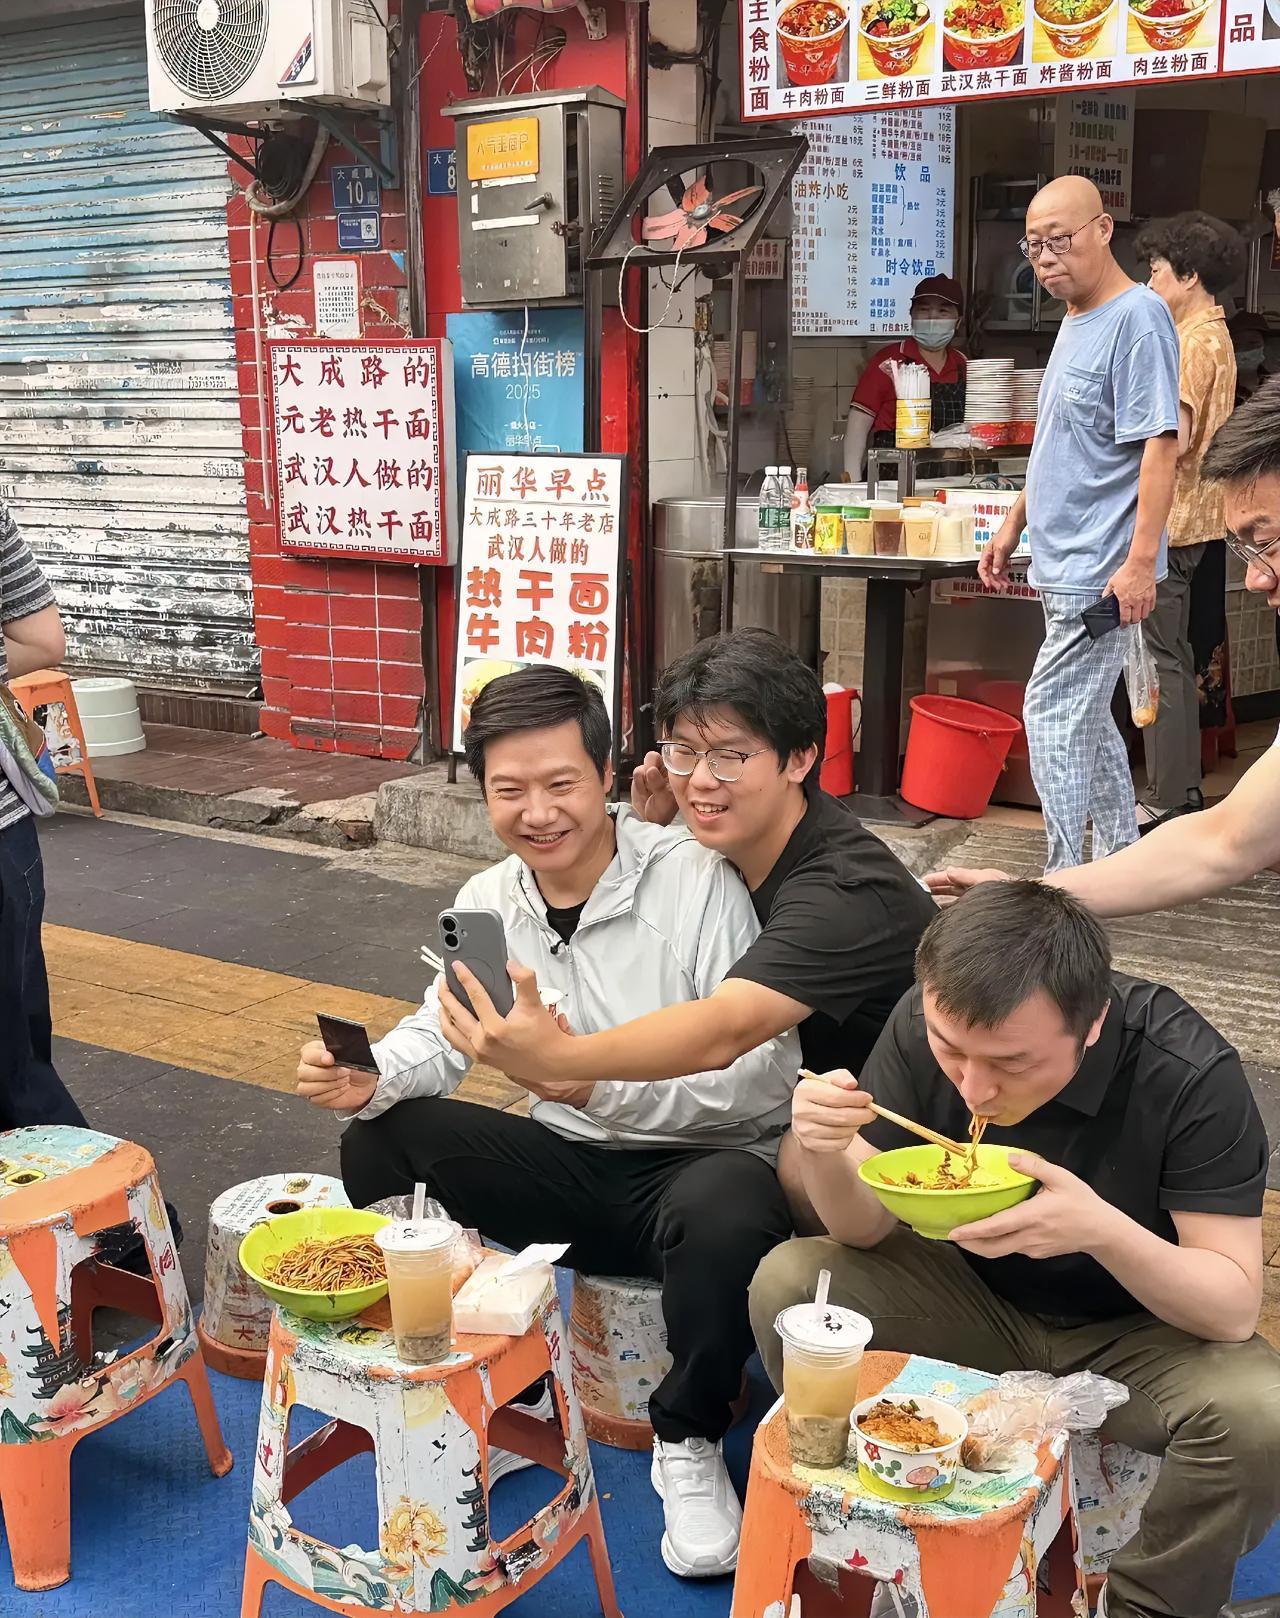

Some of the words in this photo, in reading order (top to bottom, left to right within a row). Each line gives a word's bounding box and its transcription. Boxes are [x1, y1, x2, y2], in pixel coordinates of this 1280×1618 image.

[1230, 13, 1255, 43] 品
[749, 0, 770, 112] 主食粉面
[1134, 52, 1209, 76] 肉丝粉面
[941, 68, 1028, 91] 武汉热干面
[1040, 60, 1112, 83] 炸酱粉面
[782, 86, 845, 108] 牛肉粉面
[865, 79, 931, 101] 三鲜粉面
[447, 165, 456, 189] 8
[895, 163, 930, 183] 饮品
[794, 180, 849, 200] 油炸小吃
[886, 258, 936, 275] 时令饮品
[279, 354, 430, 389] 大成路的
[470, 350, 576, 378] 高德扫街榜
[505, 384, 541, 400] 2025
[280, 405, 430, 440] 元老热干面
[284, 452, 433, 491] 武汉人做的
[477, 465, 609, 502] 丽华早点
[287, 502, 433, 542] 武汉热干面
[469, 507, 615, 534] 大成路三十年老店
[488, 534, 589, 566] 武汉人做的
[466, 566, 609, 615] 热干面
[466, 612, 610, 662] 牛肉粉
